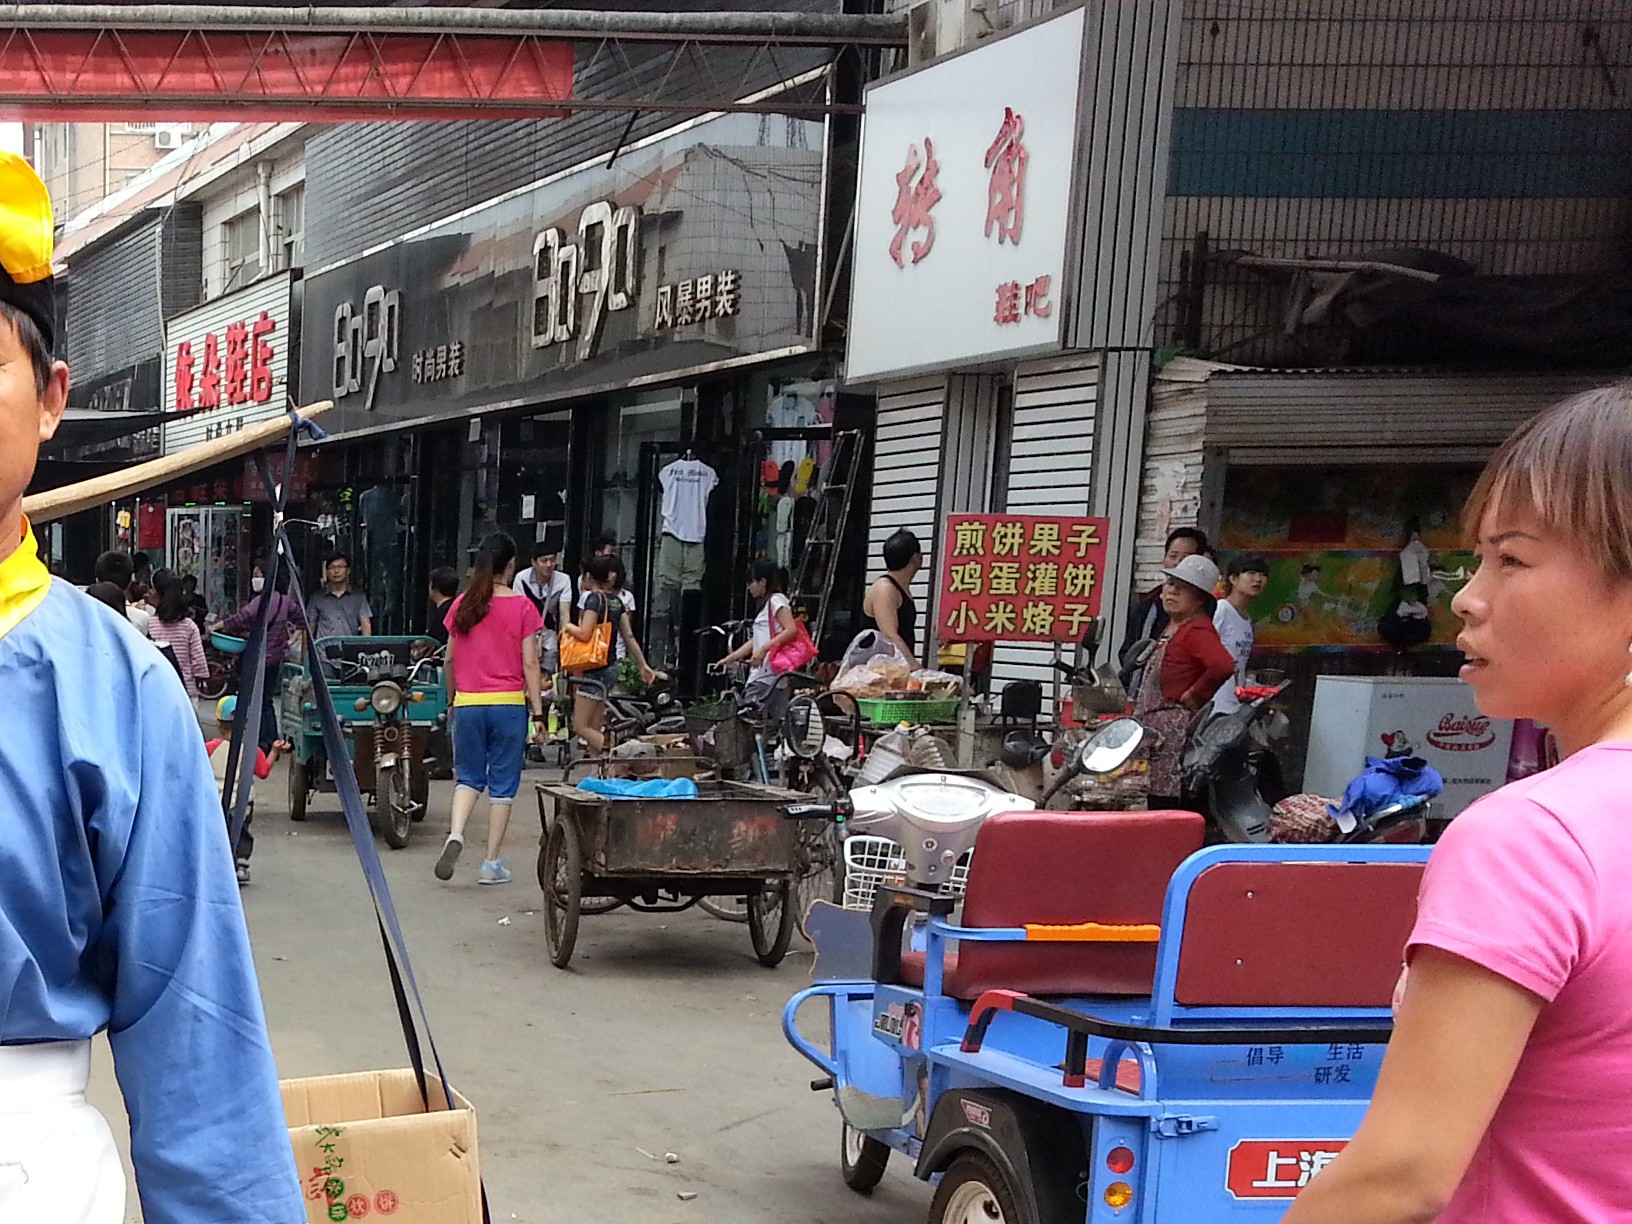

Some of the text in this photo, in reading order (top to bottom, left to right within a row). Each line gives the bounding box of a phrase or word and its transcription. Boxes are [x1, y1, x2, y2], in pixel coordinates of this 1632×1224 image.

[654, 269, 738, 330] 风暴男装
[412, 342, 465, 384] 时尚男装
[952, 521, 1100, 557] 煎饼果子
[949, 561, 1095, 597] 鸡蛋灌饼
[946, 601, 1092, 636] 小米烙子
[1246, 1043, 1365, 1066] 倡导 生活
[1314, 1065, 1351, 1084] 研发
